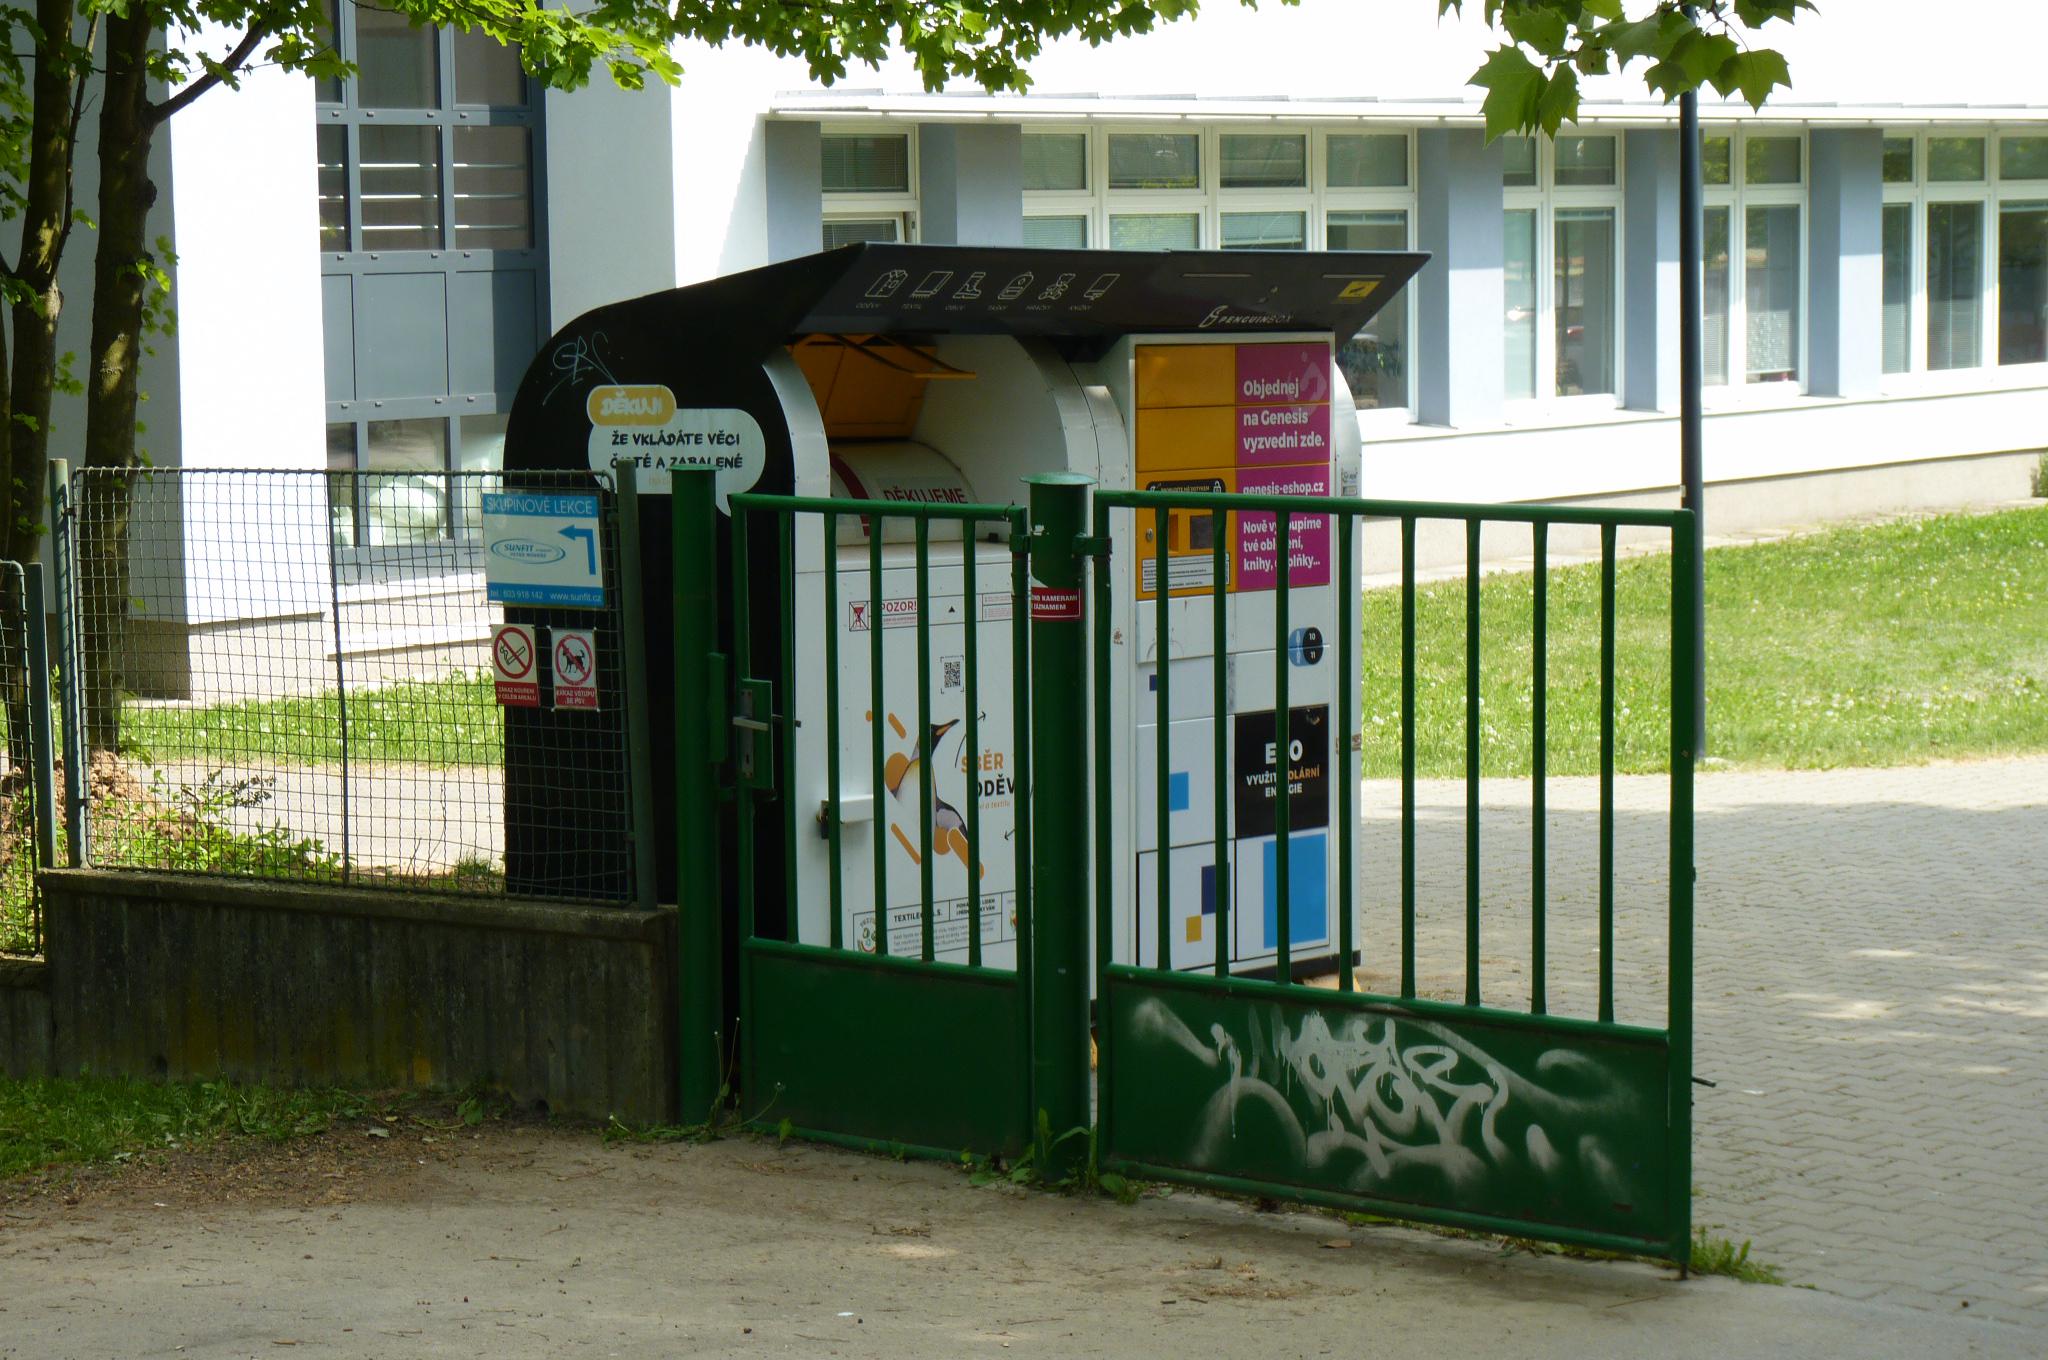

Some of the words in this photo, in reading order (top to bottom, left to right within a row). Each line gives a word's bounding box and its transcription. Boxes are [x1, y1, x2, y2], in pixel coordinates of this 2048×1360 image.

[1243, 377, 1299, 399] Objednej
[1243, 413, 1259, 426] na
[1261, 407, 1309, 426] Genesis
[612, 430, 628, 446] ŽE
[632, 429, 703, 446] VKLÁDÁTE
[708, 429, 740, 446] VĚCI
[1243, 430, 1298, 453] vyzvedni
[1300, 431, 1325, 447] zde.
[610, 452, 652, 470] ČTÉ
[656, 457, 665, 469] A
[883, 485, 968, 504] DĚKUJEME
[1243, 480, 1324, 497] genesis-eshop.cz
[487, 497, 551, 514] SKUPINOVÉ
[554, 499, 593, 515] LEKCE
[1243, 519, 1268, 534] Nově
[1269, 516, 1322, 535] vupíme
[504, 543, 534, 553] SUNFIT
[1243, 538, 1259, 552] tvé
[1260, 535, 1304, 551] oblní,
[1243, 556, 1273, 572] knihy,
[550, 591, 601, 602] www.sunfit.cz
[1041, 594, 1078, 603] KAMERAMI
[1308, 632, 1317, 641] 10
[1265, 739, 1303, 765] EO
[1286, 762, 1320, 782] OLÁRNÍ
[1265, 782, 1303, 799] ENGIE
